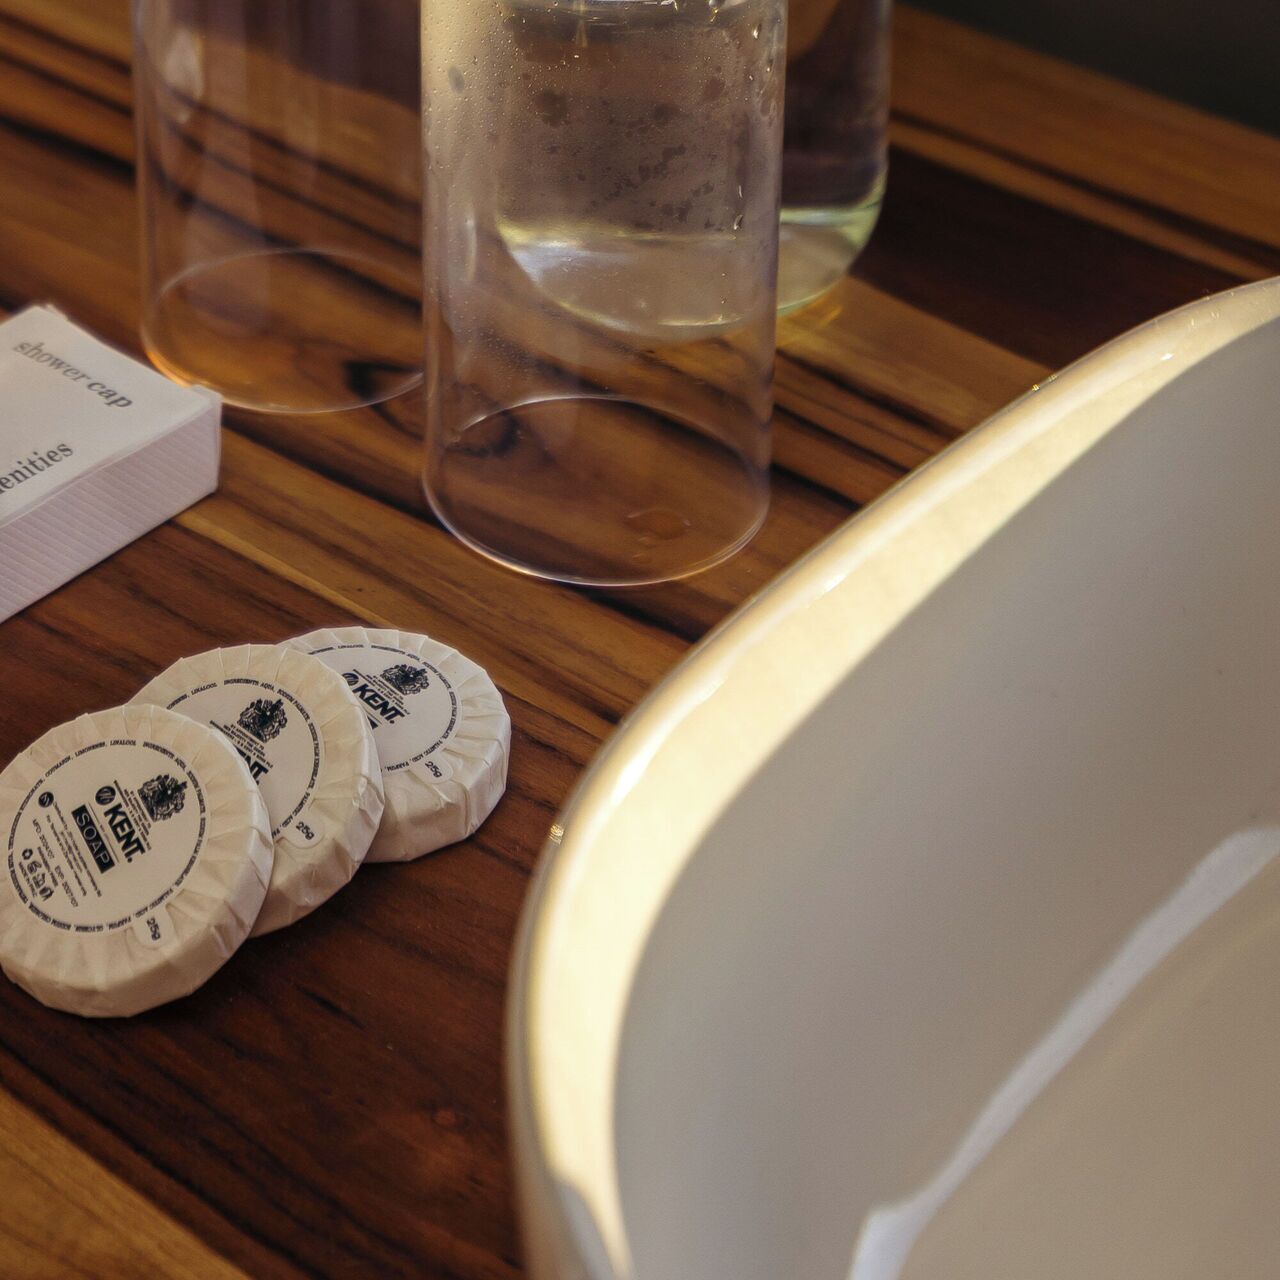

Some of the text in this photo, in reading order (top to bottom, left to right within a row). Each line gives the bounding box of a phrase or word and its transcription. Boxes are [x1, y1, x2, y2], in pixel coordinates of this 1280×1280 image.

[12, 341, 133, 408] shower cap
[425, 760, 443, 778] 25g
[76, 812, 110, 864] SOAP
[104, 802, 146, 864] KENT.
[296, 821, 315, 841] 25g
[145, 916, 162, 941] 25g
